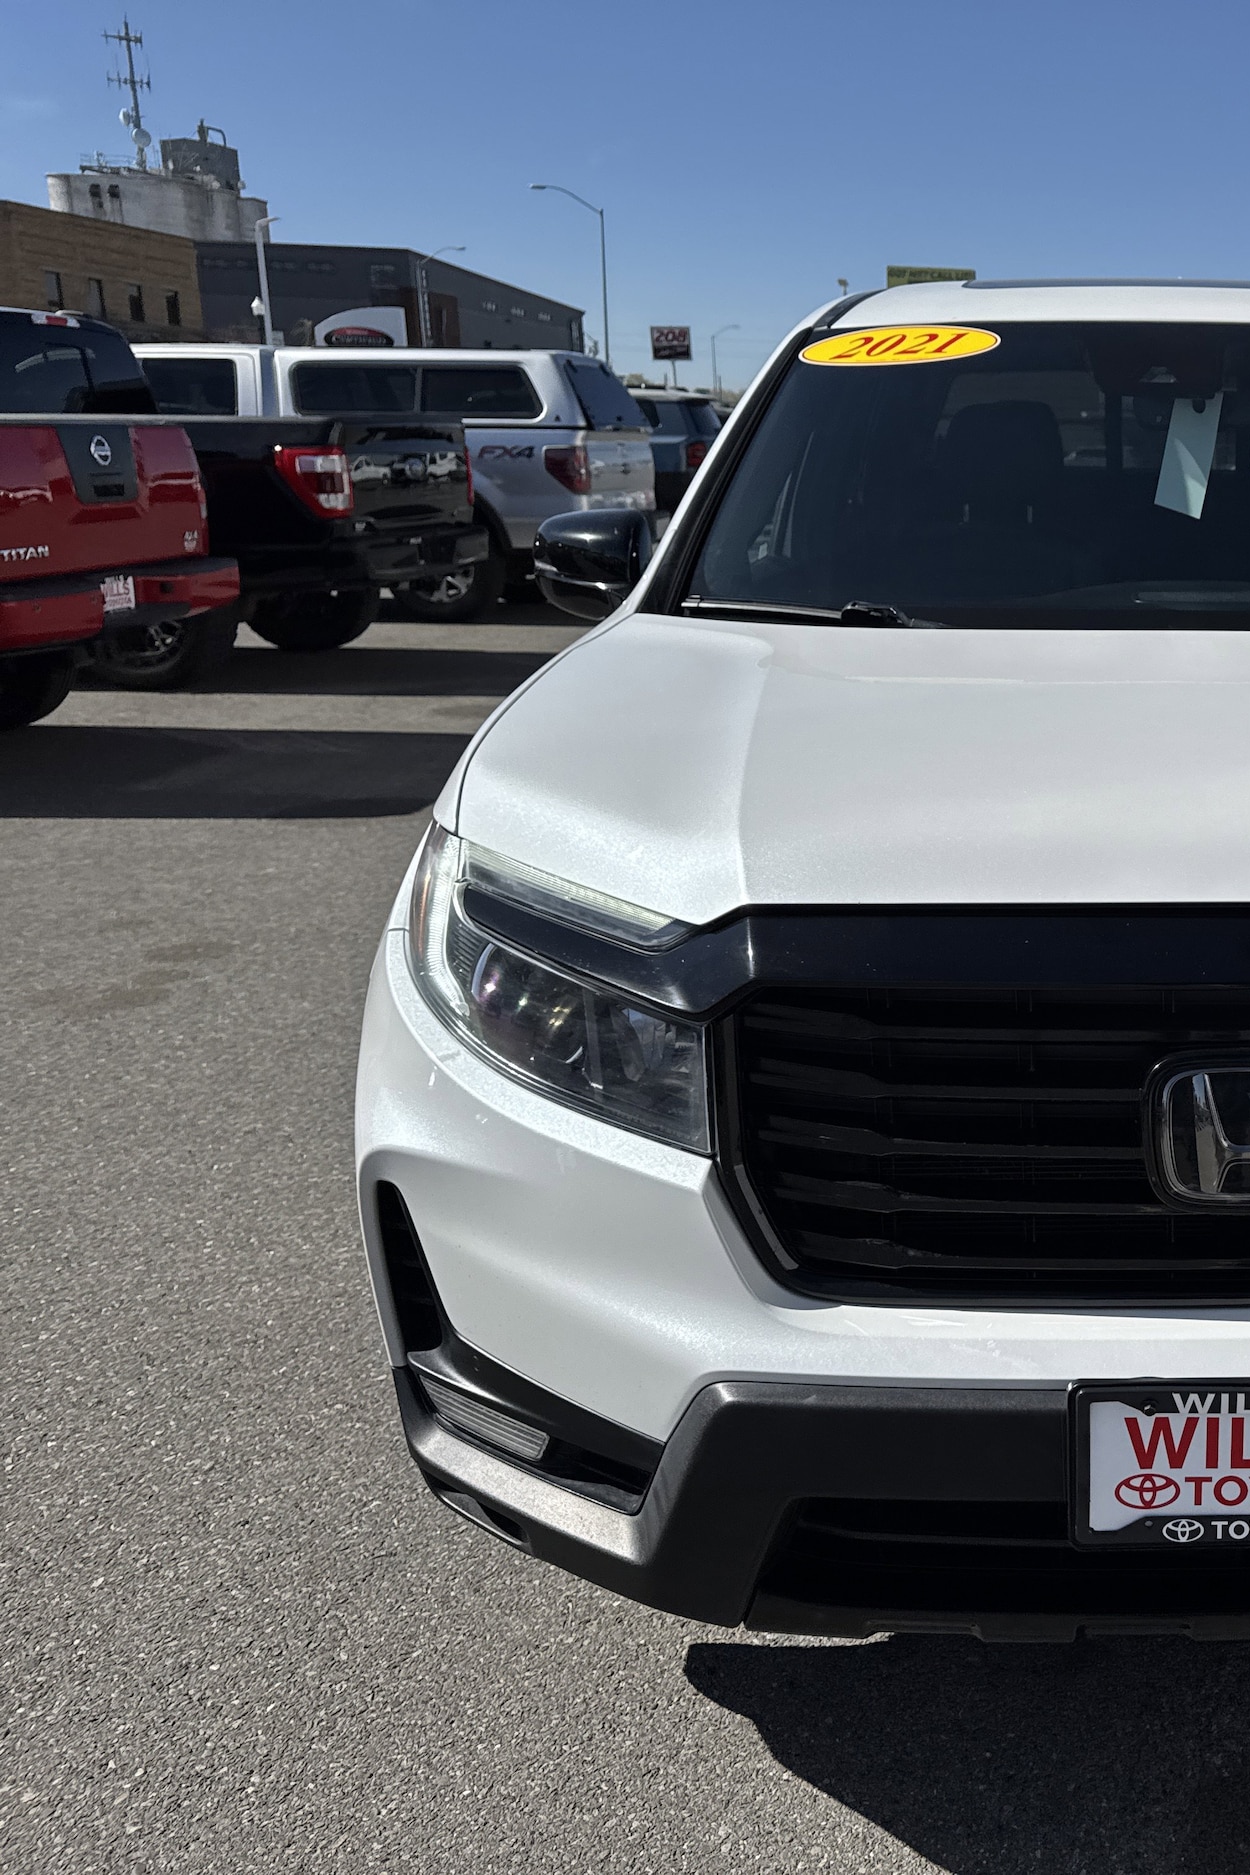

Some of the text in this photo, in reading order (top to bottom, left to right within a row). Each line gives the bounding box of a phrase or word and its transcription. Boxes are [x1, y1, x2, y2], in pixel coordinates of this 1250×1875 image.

[829, 332, 970, 360] 2021
[478, 445, 535, 459] FX4
[0, 545, 49, 561] TITAN
